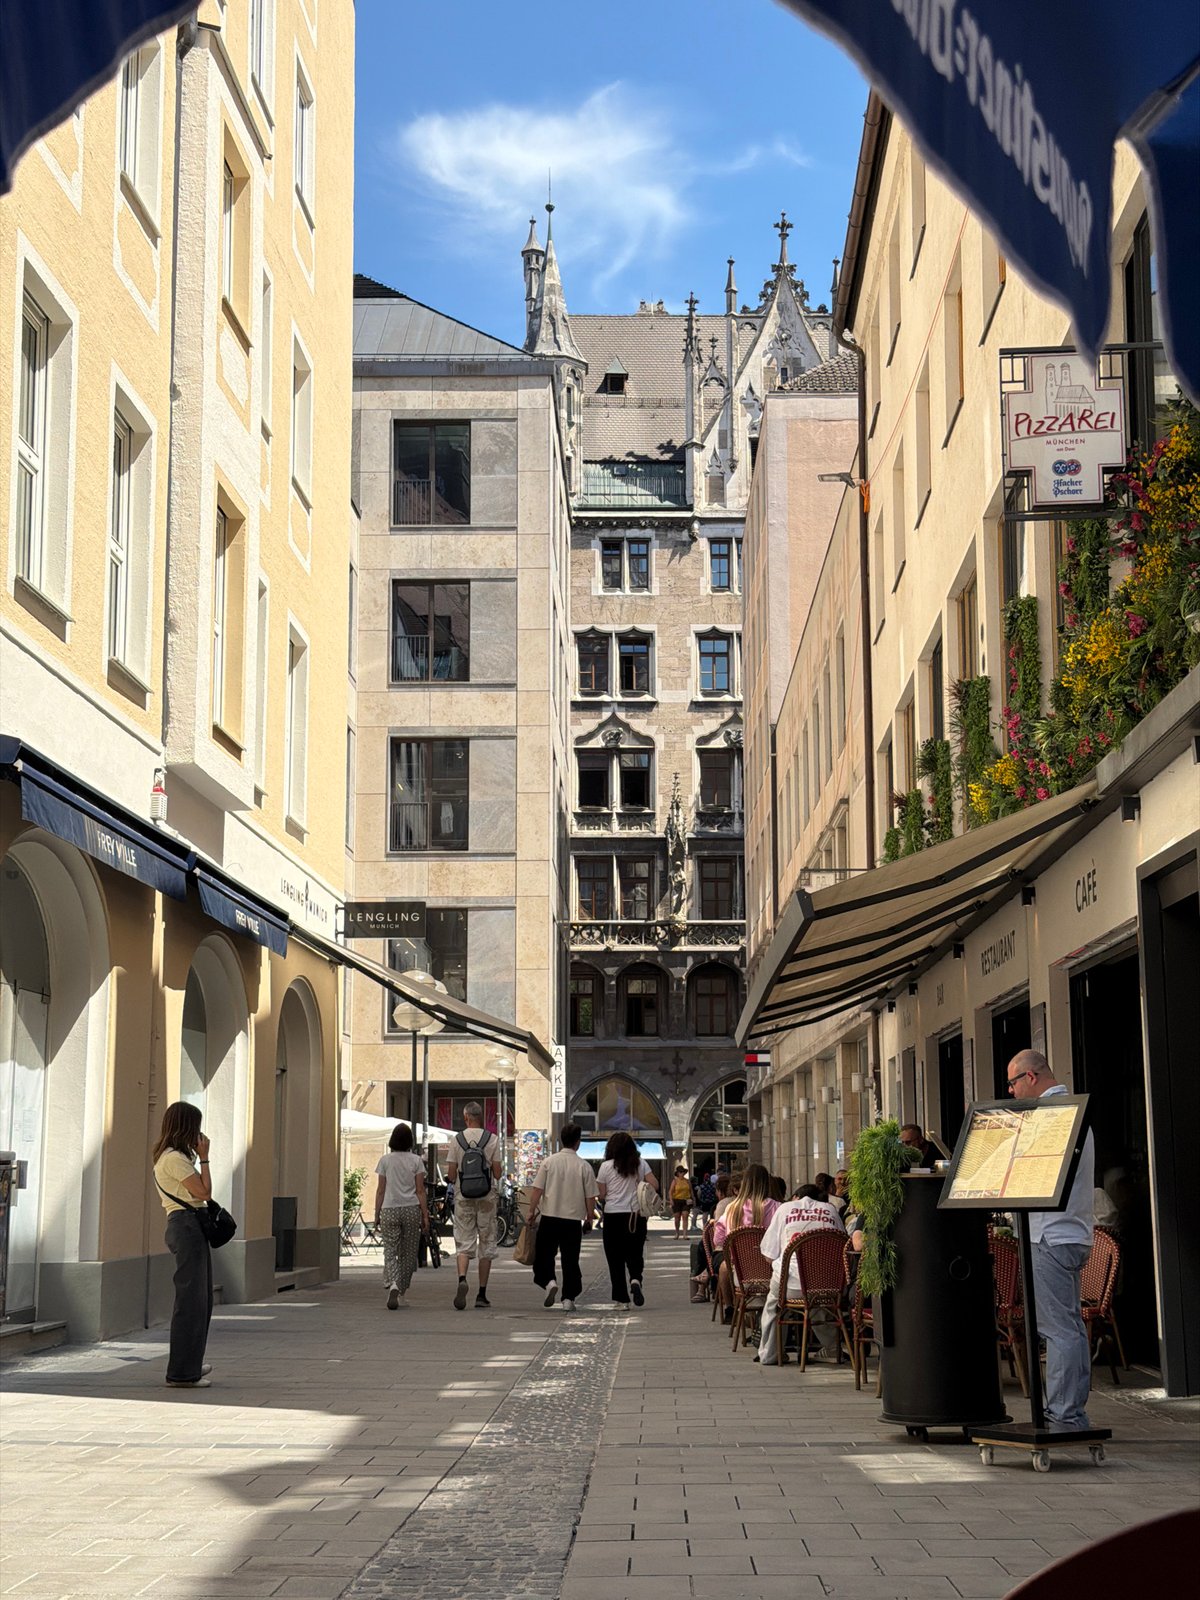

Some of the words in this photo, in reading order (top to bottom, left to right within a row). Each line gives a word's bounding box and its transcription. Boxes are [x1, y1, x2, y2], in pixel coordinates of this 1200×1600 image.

[1014, 408, 1116, 437] PIZZAREI
[1045, 437, 1086, 446] MÜNCHEN
[1053, 478, 1083, 488] Hacker
[1052, 487, 1083, 498] Pschorr
[349, 912, 421, 922] LENGLING
[980, 929, 1016, 977] RESTAURANT
[553, 1047, 563, 1111] ARKET
[791, 1207, 831, 1216] arctic
[785, 1213, 836, 1226] infusion
